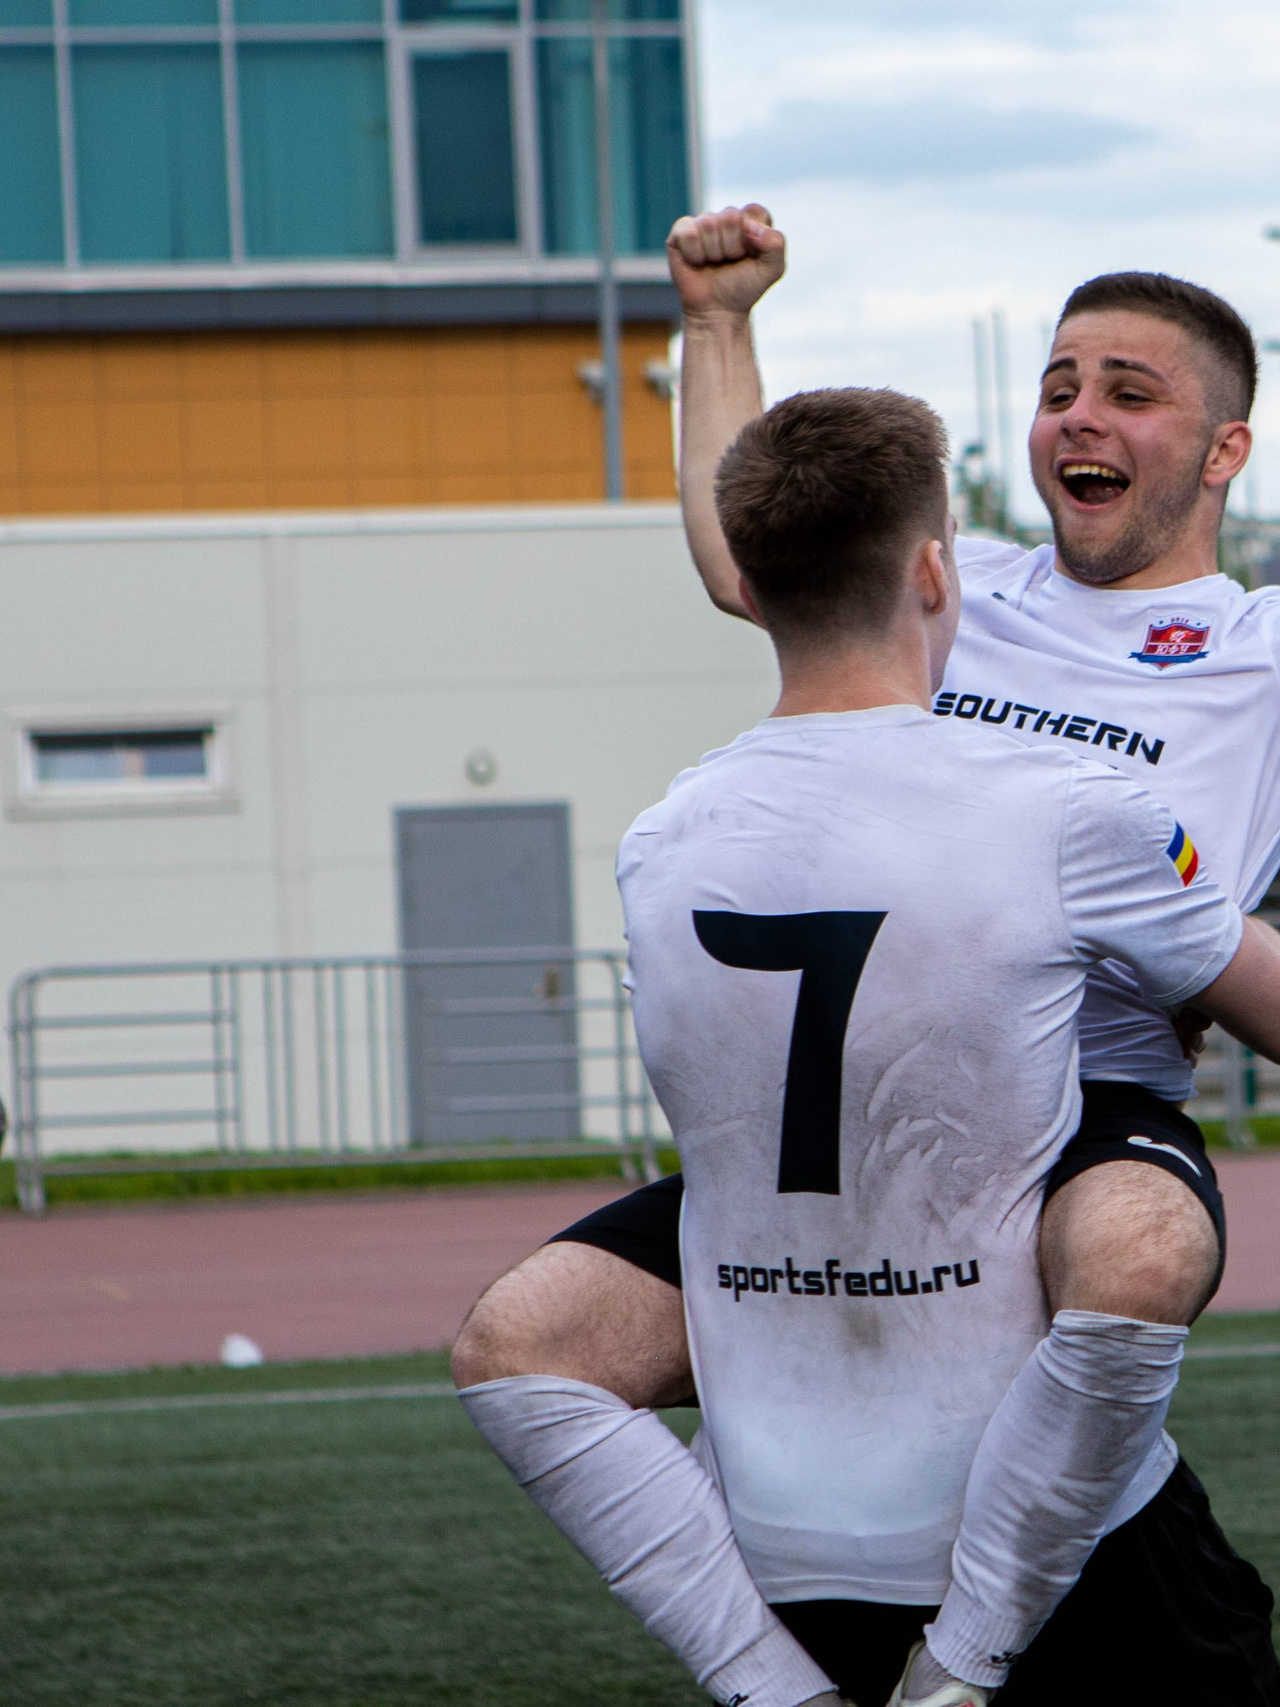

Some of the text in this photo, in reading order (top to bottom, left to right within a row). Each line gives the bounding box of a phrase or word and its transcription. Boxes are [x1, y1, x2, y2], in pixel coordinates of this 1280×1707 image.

[933, 692, 1165, 766] SOUTHERN
[692, 909, 888, 1196] 7
[717, 1257, 980, 1302] sportsfedu.ru
